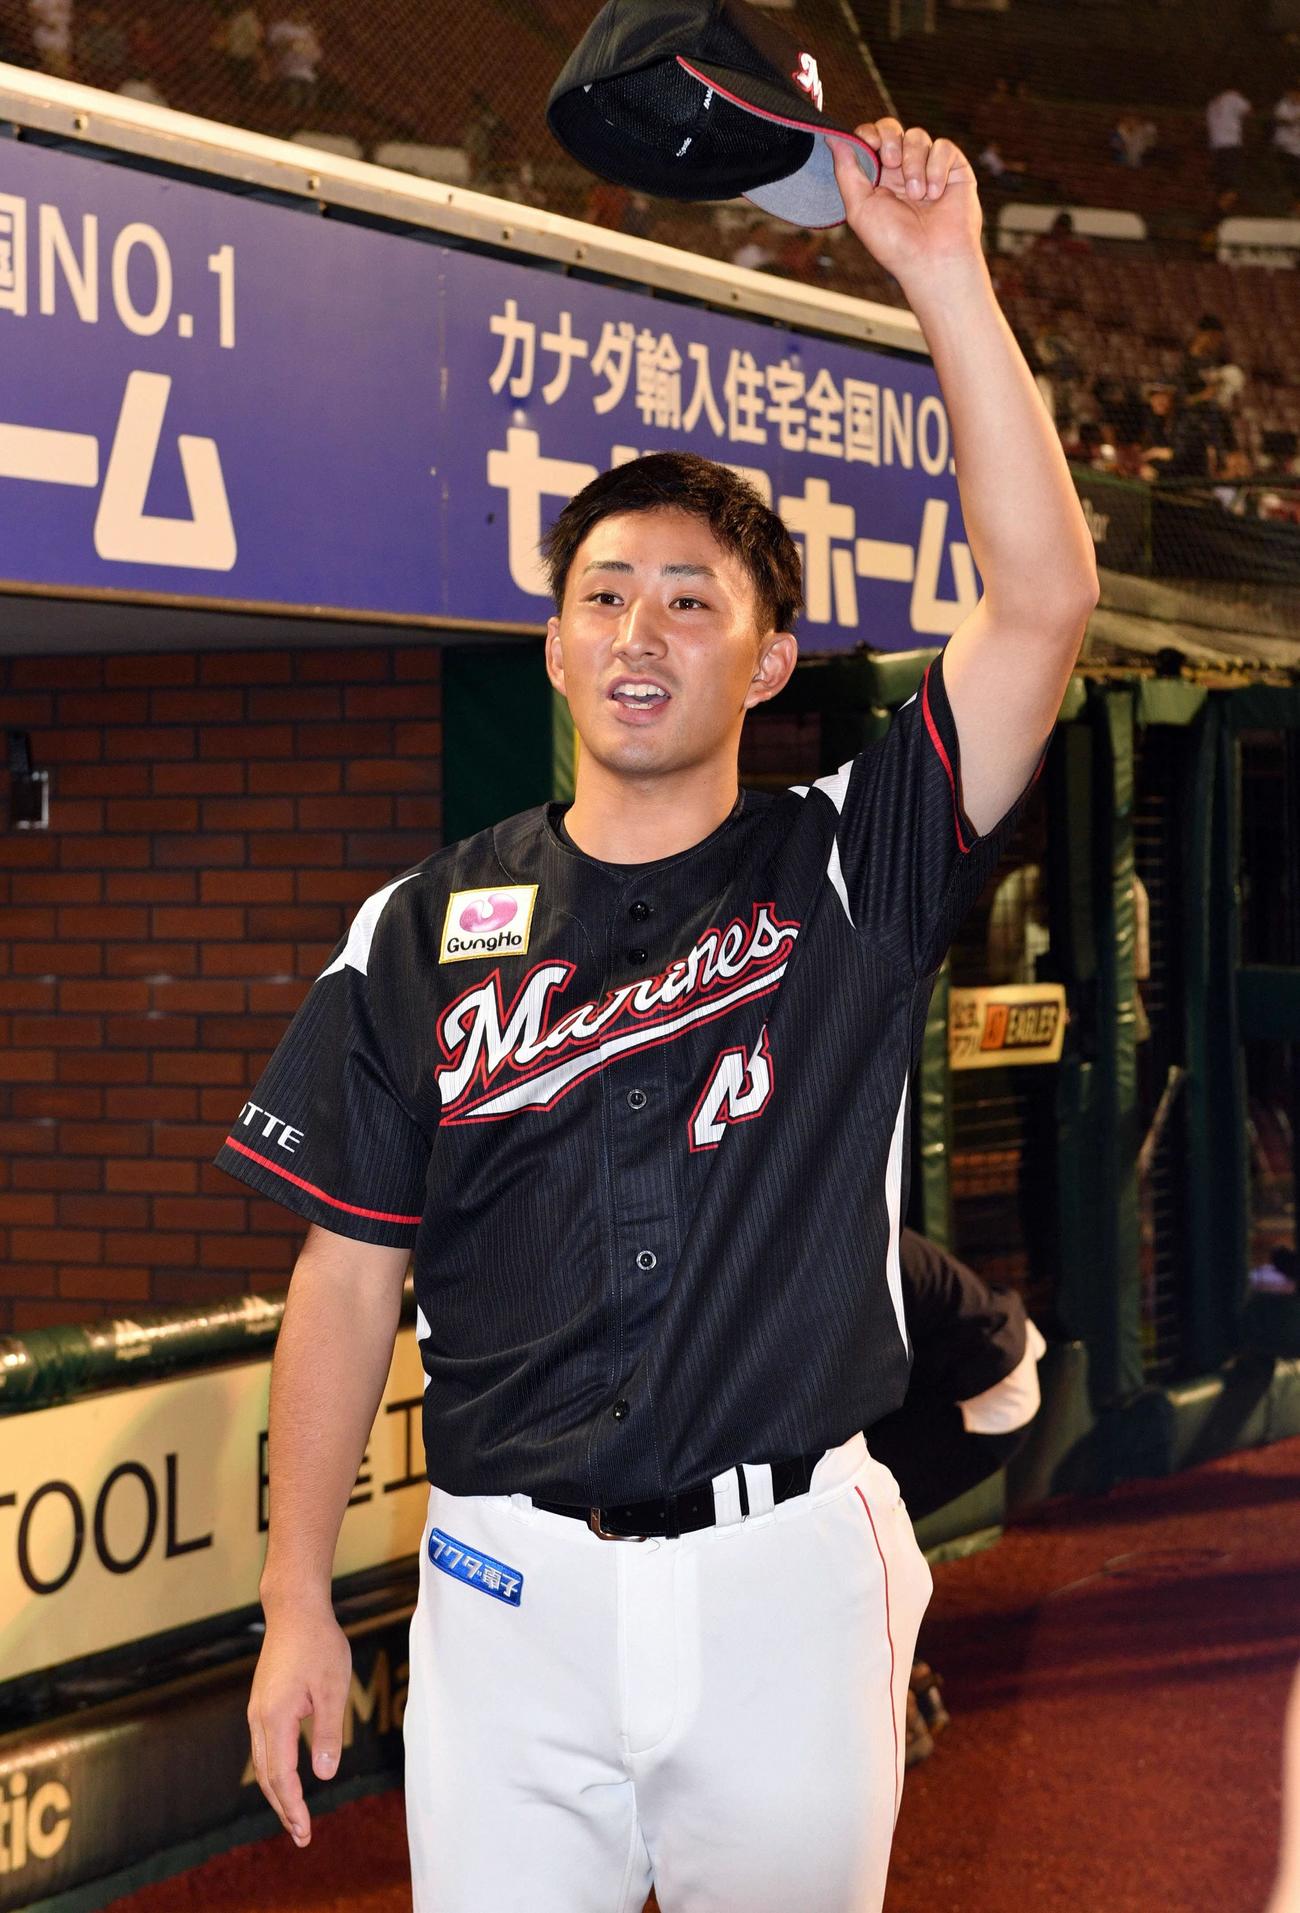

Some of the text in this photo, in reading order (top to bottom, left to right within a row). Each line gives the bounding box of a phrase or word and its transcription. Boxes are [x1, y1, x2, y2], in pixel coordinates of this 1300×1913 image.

[487, 427, 980, 635] セホーム
[446, 931, 522, 954] GungHo
[435, 902, 801, 1114] Marines
[238, 1101, 305, 1153] TTE
